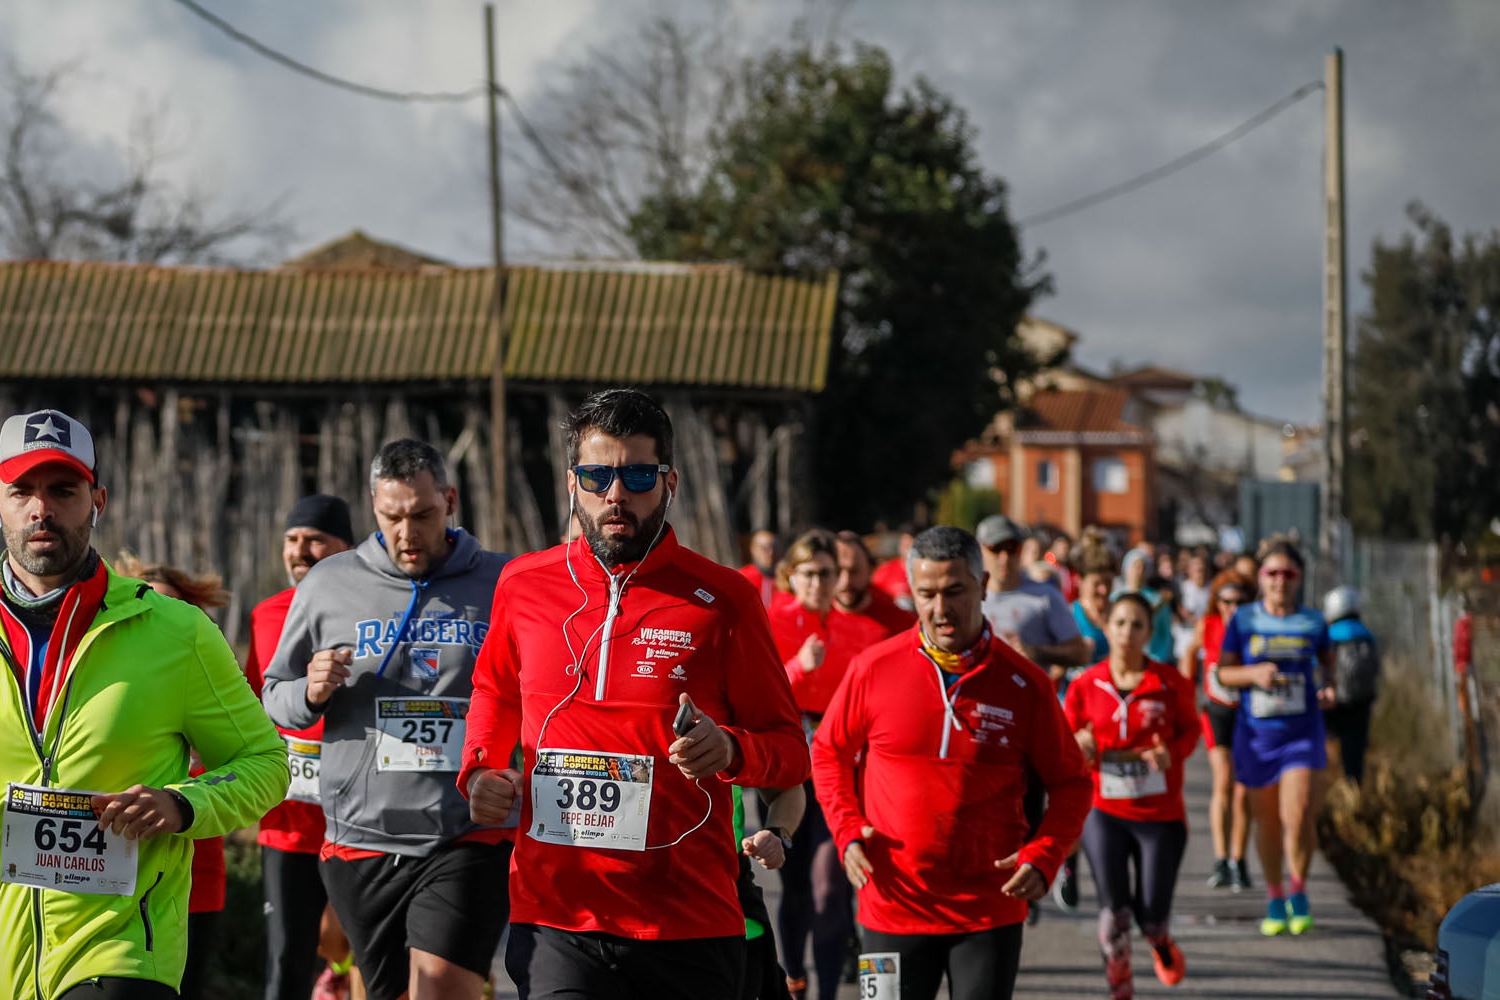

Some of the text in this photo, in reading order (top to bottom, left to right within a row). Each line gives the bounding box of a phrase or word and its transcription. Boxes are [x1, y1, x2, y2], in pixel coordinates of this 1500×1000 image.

[640, 627, 692, 640] VII CARRERA
[652, 634, 692, 644] POPULAR
[401, 719, 454, 744] 257
[563, 755, 606, 765] CARRERA
[563, 762, 606, 771] POPULAR
[12, 789, 25, 799] 26
[42, 793, 92, 805] CARRERA
[556, 778, 621, 813] 389
[39, 807, 69, 816] Secaderos
[42, 801, 91, 811] POPULAR
[560, 811, 615, 828] PEPE BÉJAR
[34, 818, 108, 856] 654
[581, 829, 605, 838] olimpo
[35, 852, 106, 872] JUAN CARLOS
[64, 873, 91, 883] olimpo
